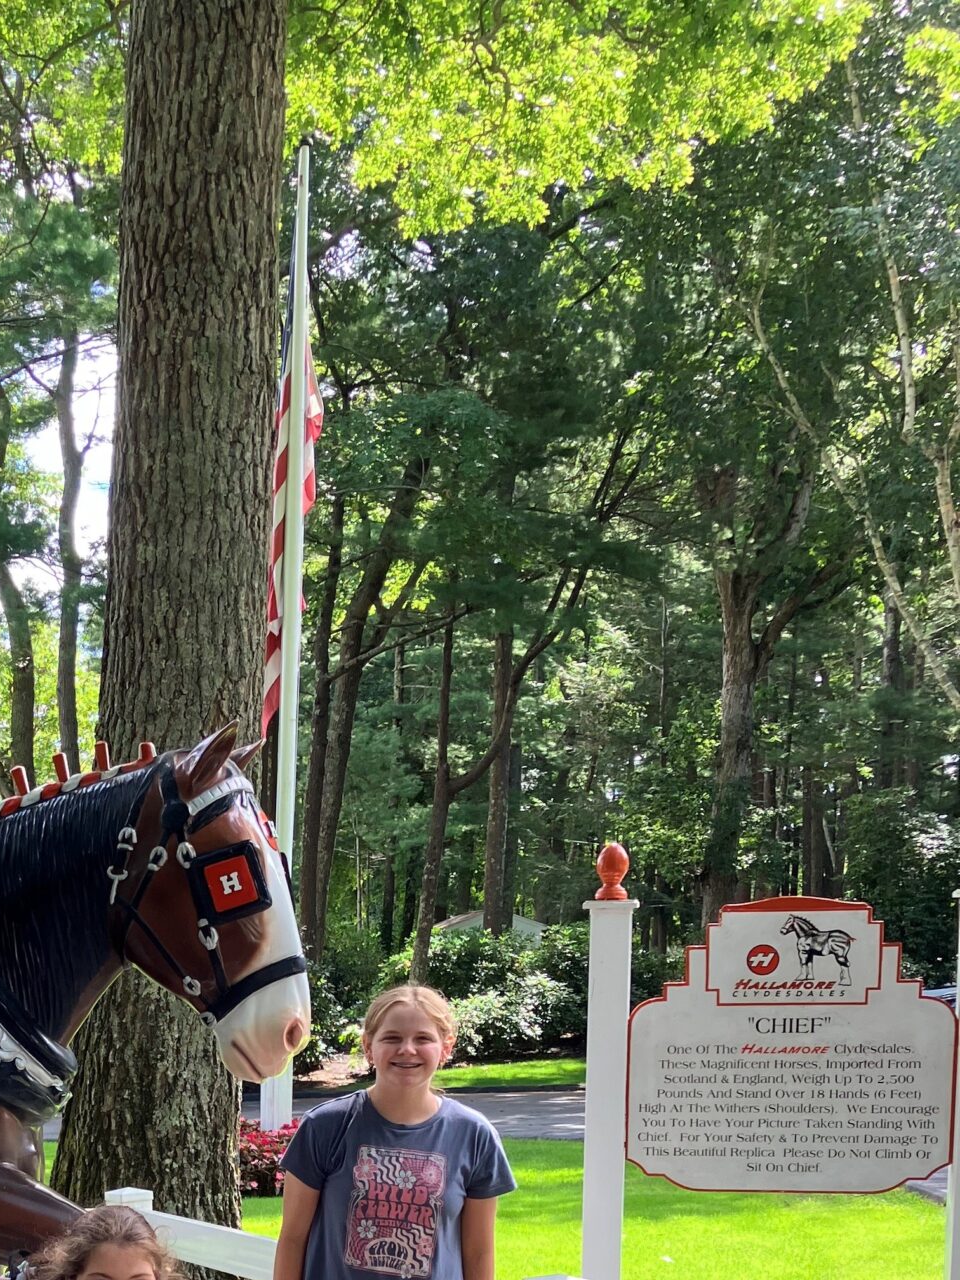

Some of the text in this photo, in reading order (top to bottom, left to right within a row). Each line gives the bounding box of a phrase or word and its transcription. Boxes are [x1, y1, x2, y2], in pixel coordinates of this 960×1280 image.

[220, 872, 242, 895] H
[734, 979, 837, 990] HALLAMORE
[748, 1017, 831, 1034] "CHIEF"
[667, 1044, 692, 1055] One
[696, 1044, 711, 1055] Of
[714, 1044, 738, 1055] The
[740, 1043, 830, 1054] HALLAMORE
[659, 1059, 696, 1070] These
[701, 1059, 770, 1071] Magnificent
[826, 1059, 884, 1071] Imported
[888, 1059, 921, 1069] From
[664, 1074, 915, 1086] Scotland & England, Weigh Up To 2,500
[657, 1089, 921, 1100] Pounds And Stand Over 18 Hands (6 Feet)
[639, 1103, 666, 1115] High
[670, 1104, 683, 1113] At
[687, 1103, 711, 1113] The
[714, 1103, 760, 1113] Withers
[847, 1104, 867, 1113] We
[871, 1104, 940, 1116] Encourage
[642, 1118, 935, 1131] You To Have Your Picture Taken Standing With
[680, 1132, 700, 1142] For
[703, 1132, 733, 1142] Your
[736, 1133, 775, 1144] Safety
[779, 1134, 787, 1143] &
[791, 1134, 808, 1143] To
[812, 1134, 860, 1144] Prevent
[863, 1134, 917, 1146] Damage
[921, 1135, 939, 1144] To
[643, 1147, 669, 1156] This
[673, 1147, 726, 1157] Beautiful
[783, 1148, 824, 1158] Please
[828, 1149, 846, 1158] Do
[849, 1149, 871, 1159] Not
[875, 1149, 912, 1159] Climb
[916, 1150, 932, 1159] Or
[746, 1162, 761, 1172] Sit
[766, 1162, 784, 1172] On
[368, 1179, 428, 1205] WILD
[356, 1200, 433, 1228] FLOWER
[375, 1219, 413, 1229] FESTIVAL
[368, 1241, 408, 1259] GROW
